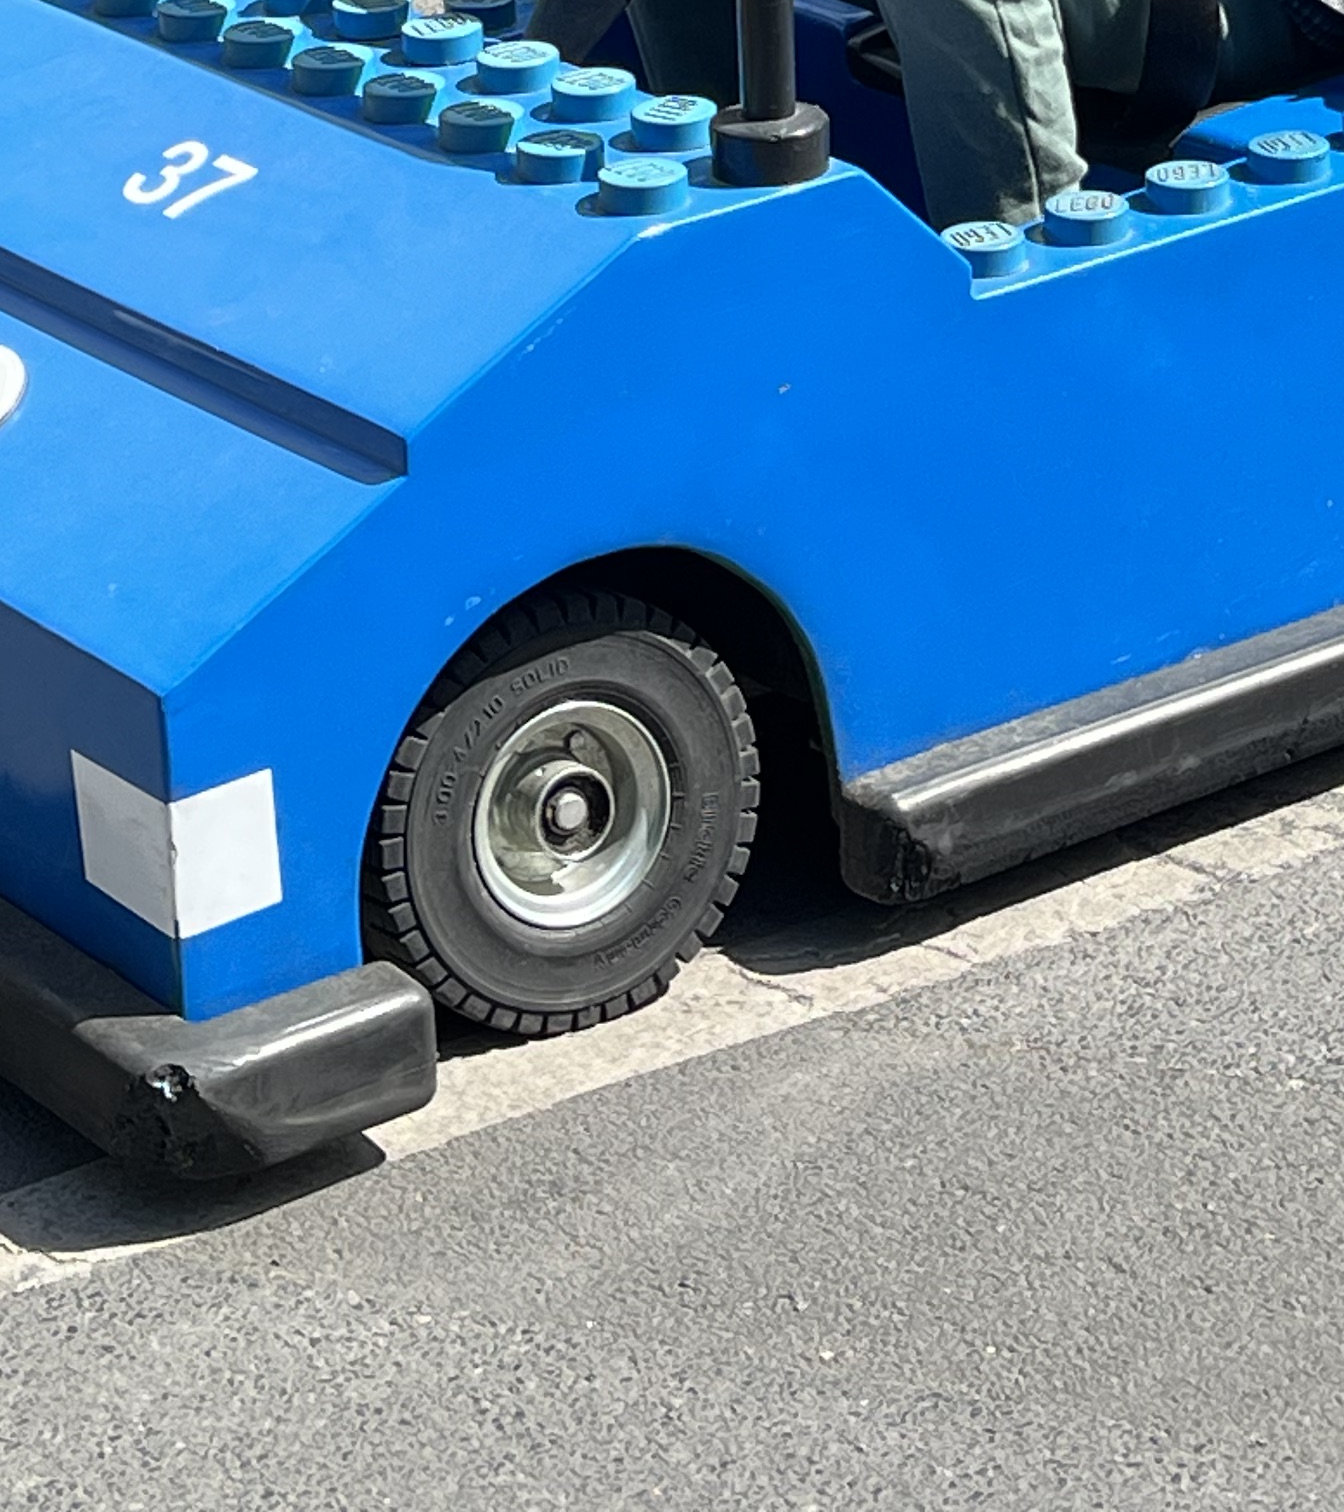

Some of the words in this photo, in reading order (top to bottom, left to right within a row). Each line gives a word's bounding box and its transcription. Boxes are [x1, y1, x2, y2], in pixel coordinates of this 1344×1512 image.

[122, 140, 259, 220] 37
[1053, 192, 1116, 214] LEGO
[510, 656, 570, 697] SOLID
